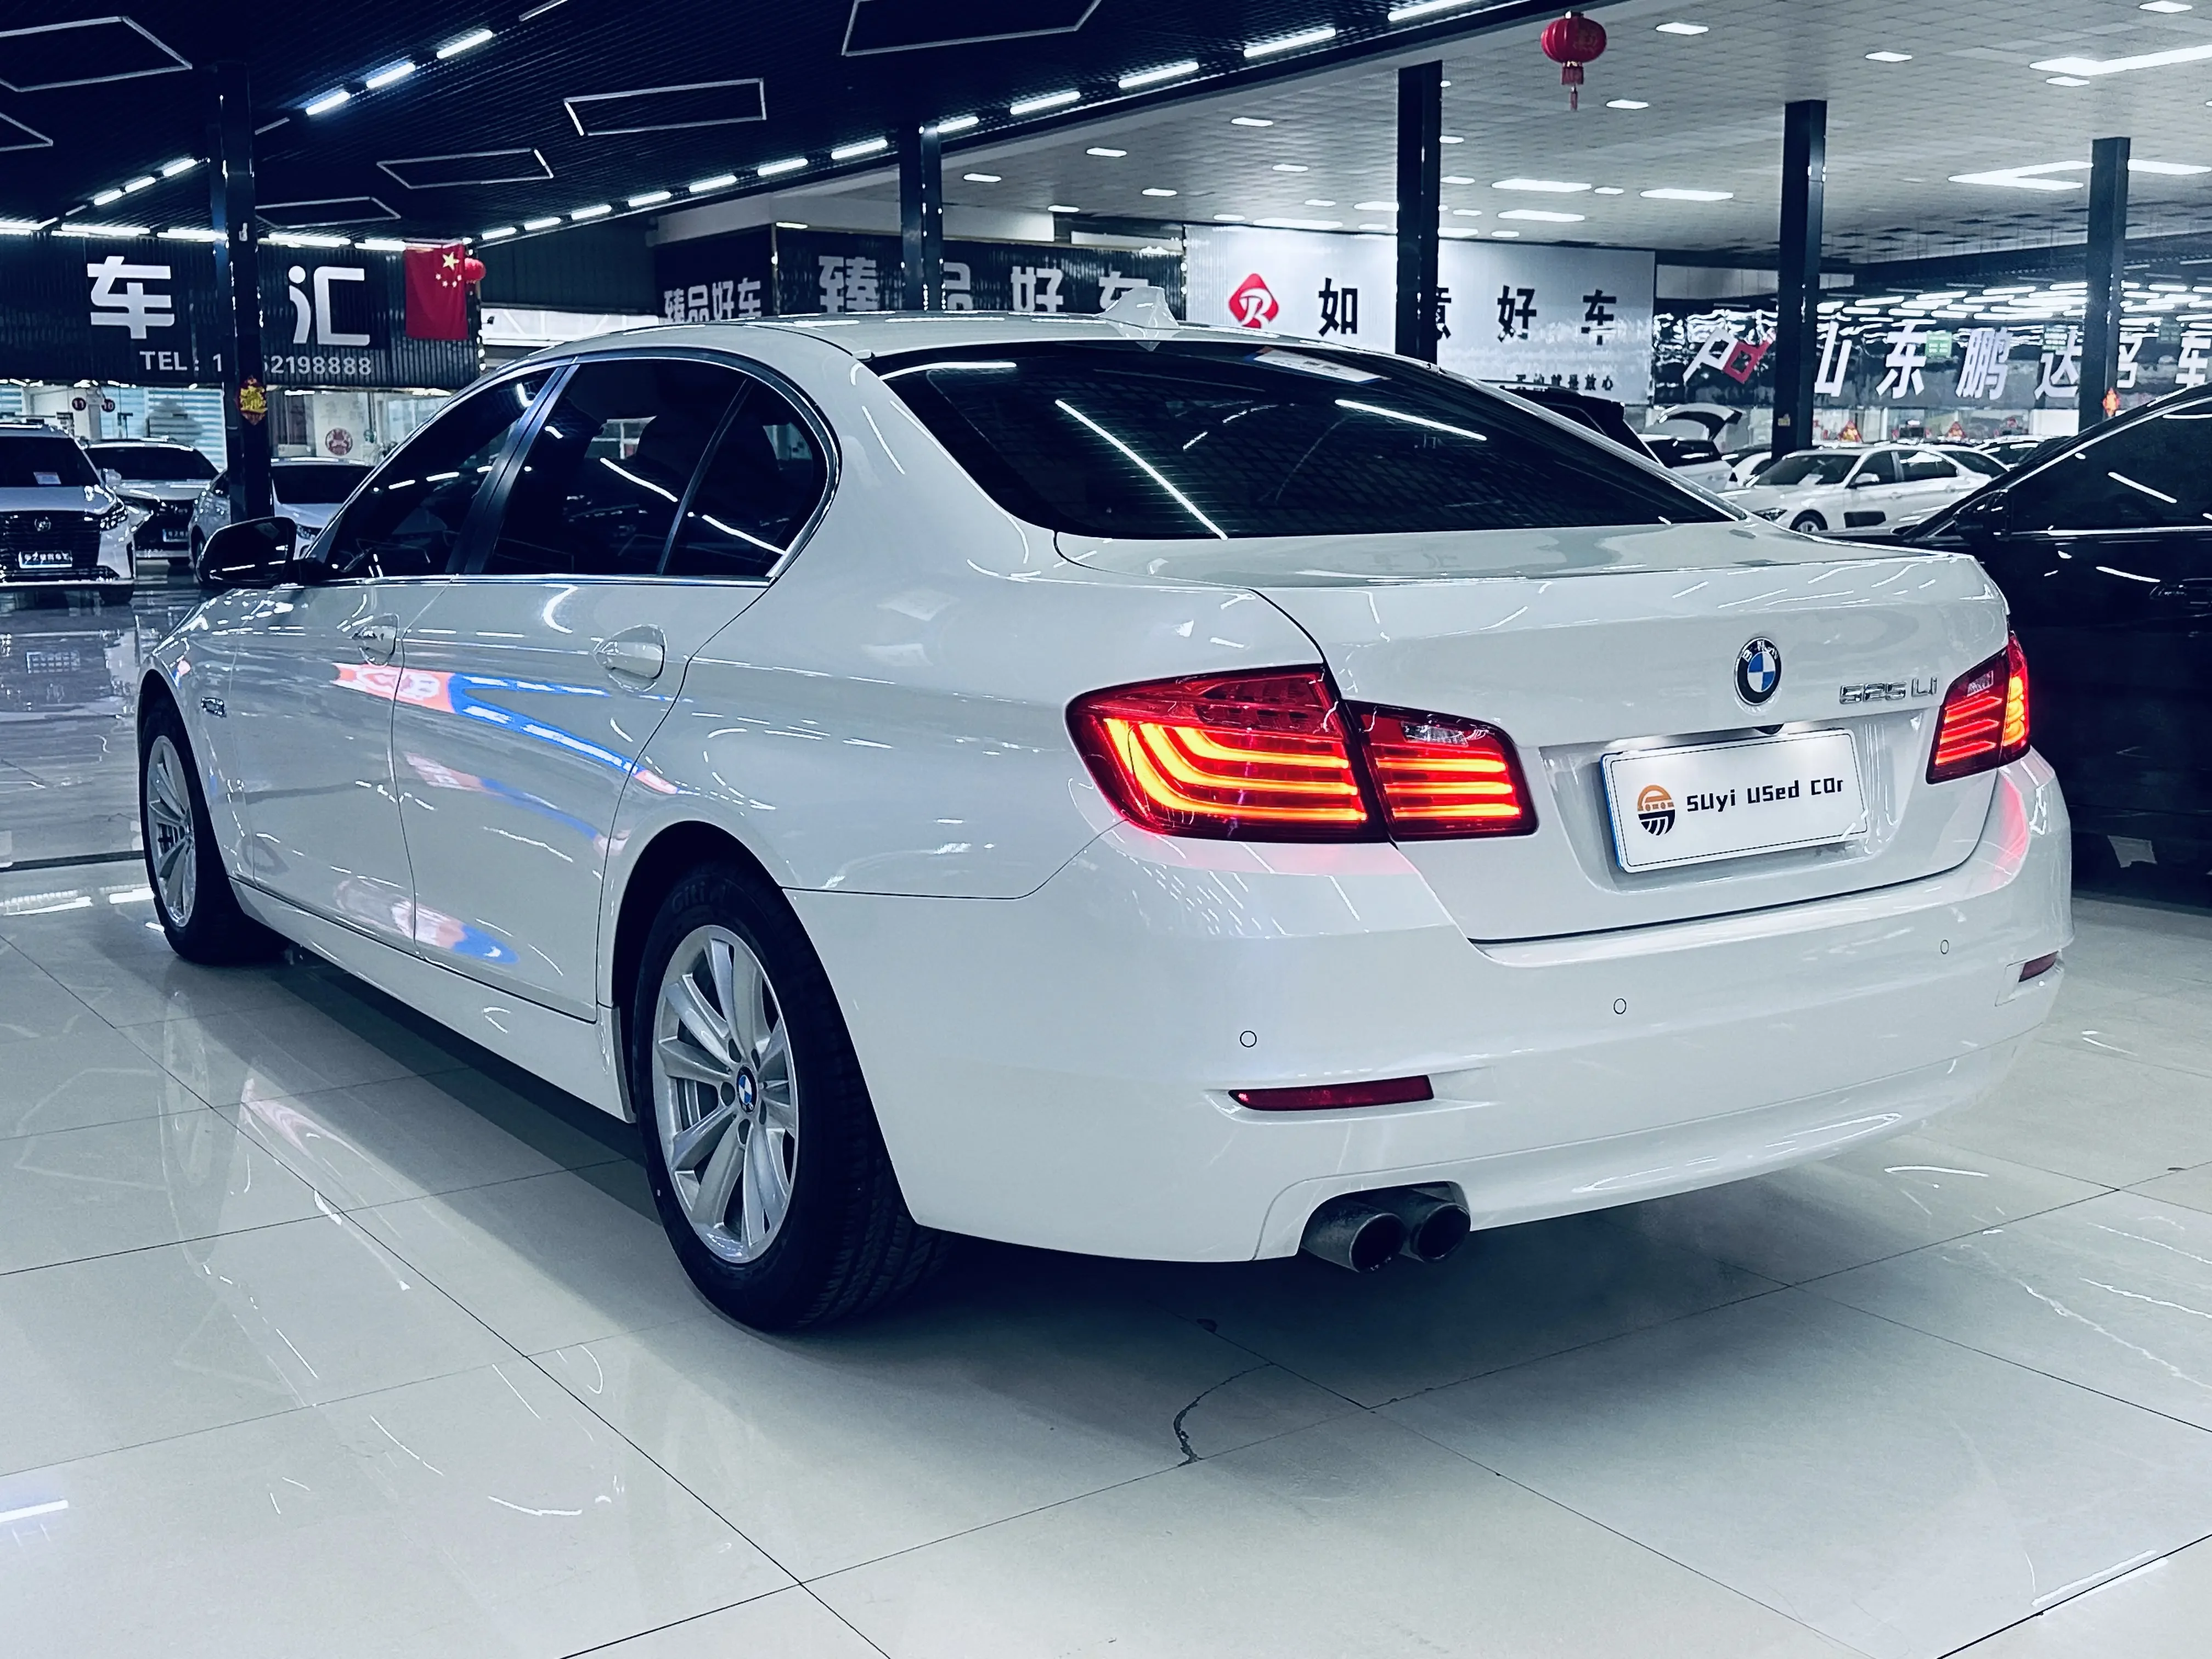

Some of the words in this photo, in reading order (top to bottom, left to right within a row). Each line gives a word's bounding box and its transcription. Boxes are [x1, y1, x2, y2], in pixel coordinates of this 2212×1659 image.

[664, 277, 761, 323] 臻品好车
[212, 354, 372, 375] 12198888
